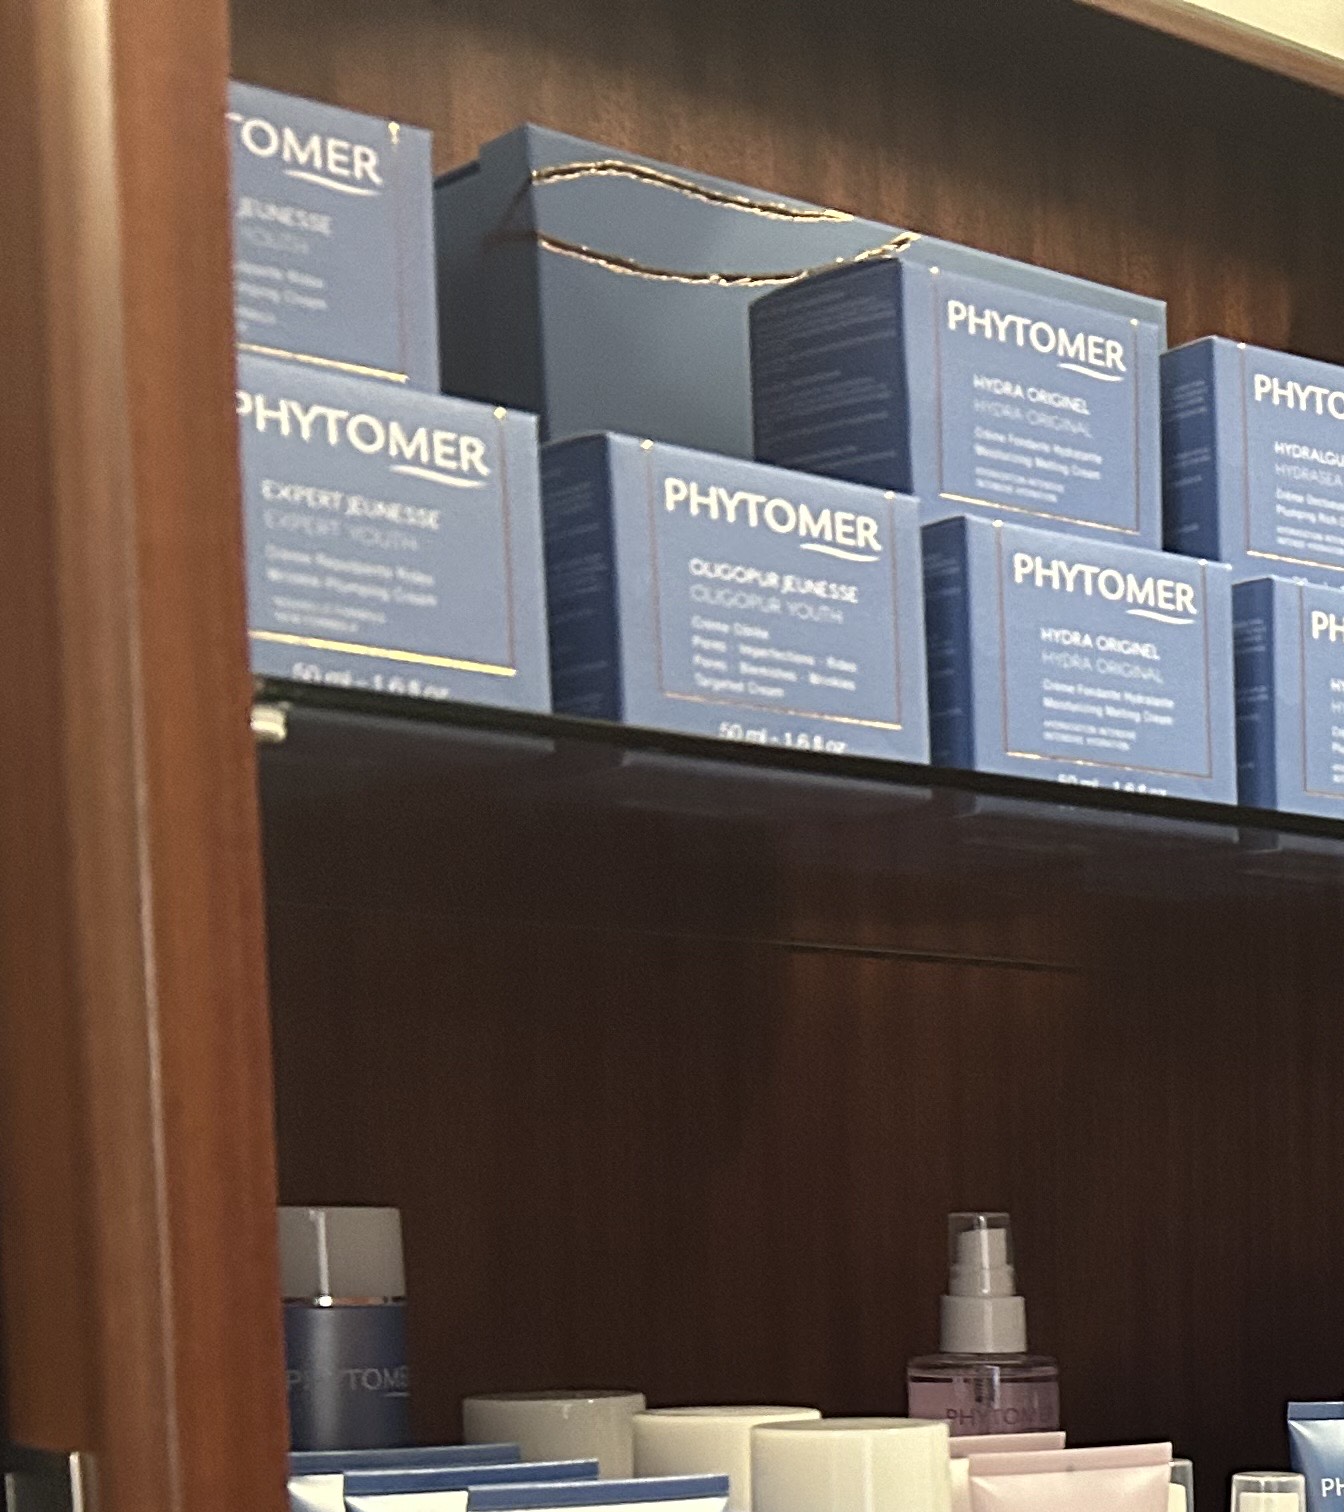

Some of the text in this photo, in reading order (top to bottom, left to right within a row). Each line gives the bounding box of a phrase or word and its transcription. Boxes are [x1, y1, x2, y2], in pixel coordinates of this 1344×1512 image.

[947, 299, 1127, 373] PHYTOMER
[973, 374, 1025, 400] HYDRA
[663, 476, 883, 552] PHYTOMER
[1012, 552, 1198, 615] PHYTOMER
[1040, 627, 1093, 649] HYDRA
